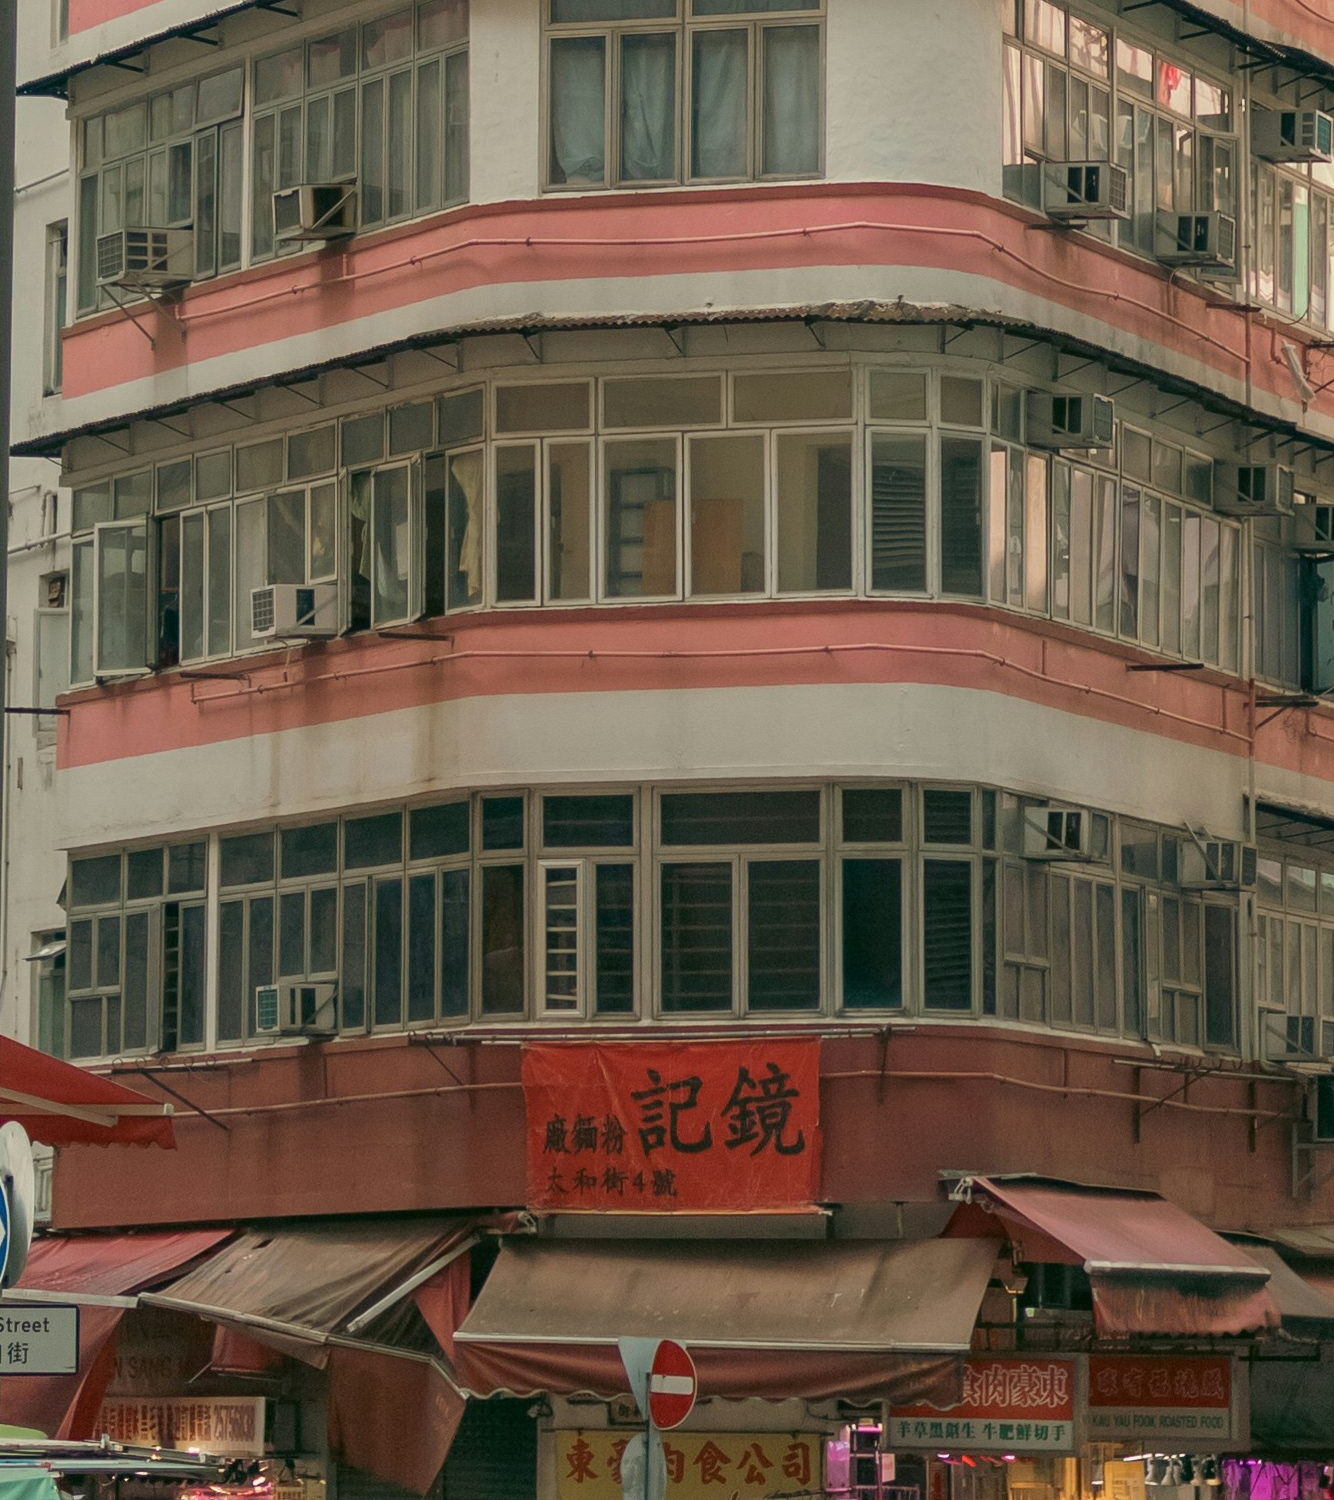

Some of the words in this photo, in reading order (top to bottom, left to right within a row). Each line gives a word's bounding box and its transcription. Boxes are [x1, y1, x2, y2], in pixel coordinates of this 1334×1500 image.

[545, 1166, 678, 1197] 太和街4號
[1200, 1415, 1224, 1429] FOOD
